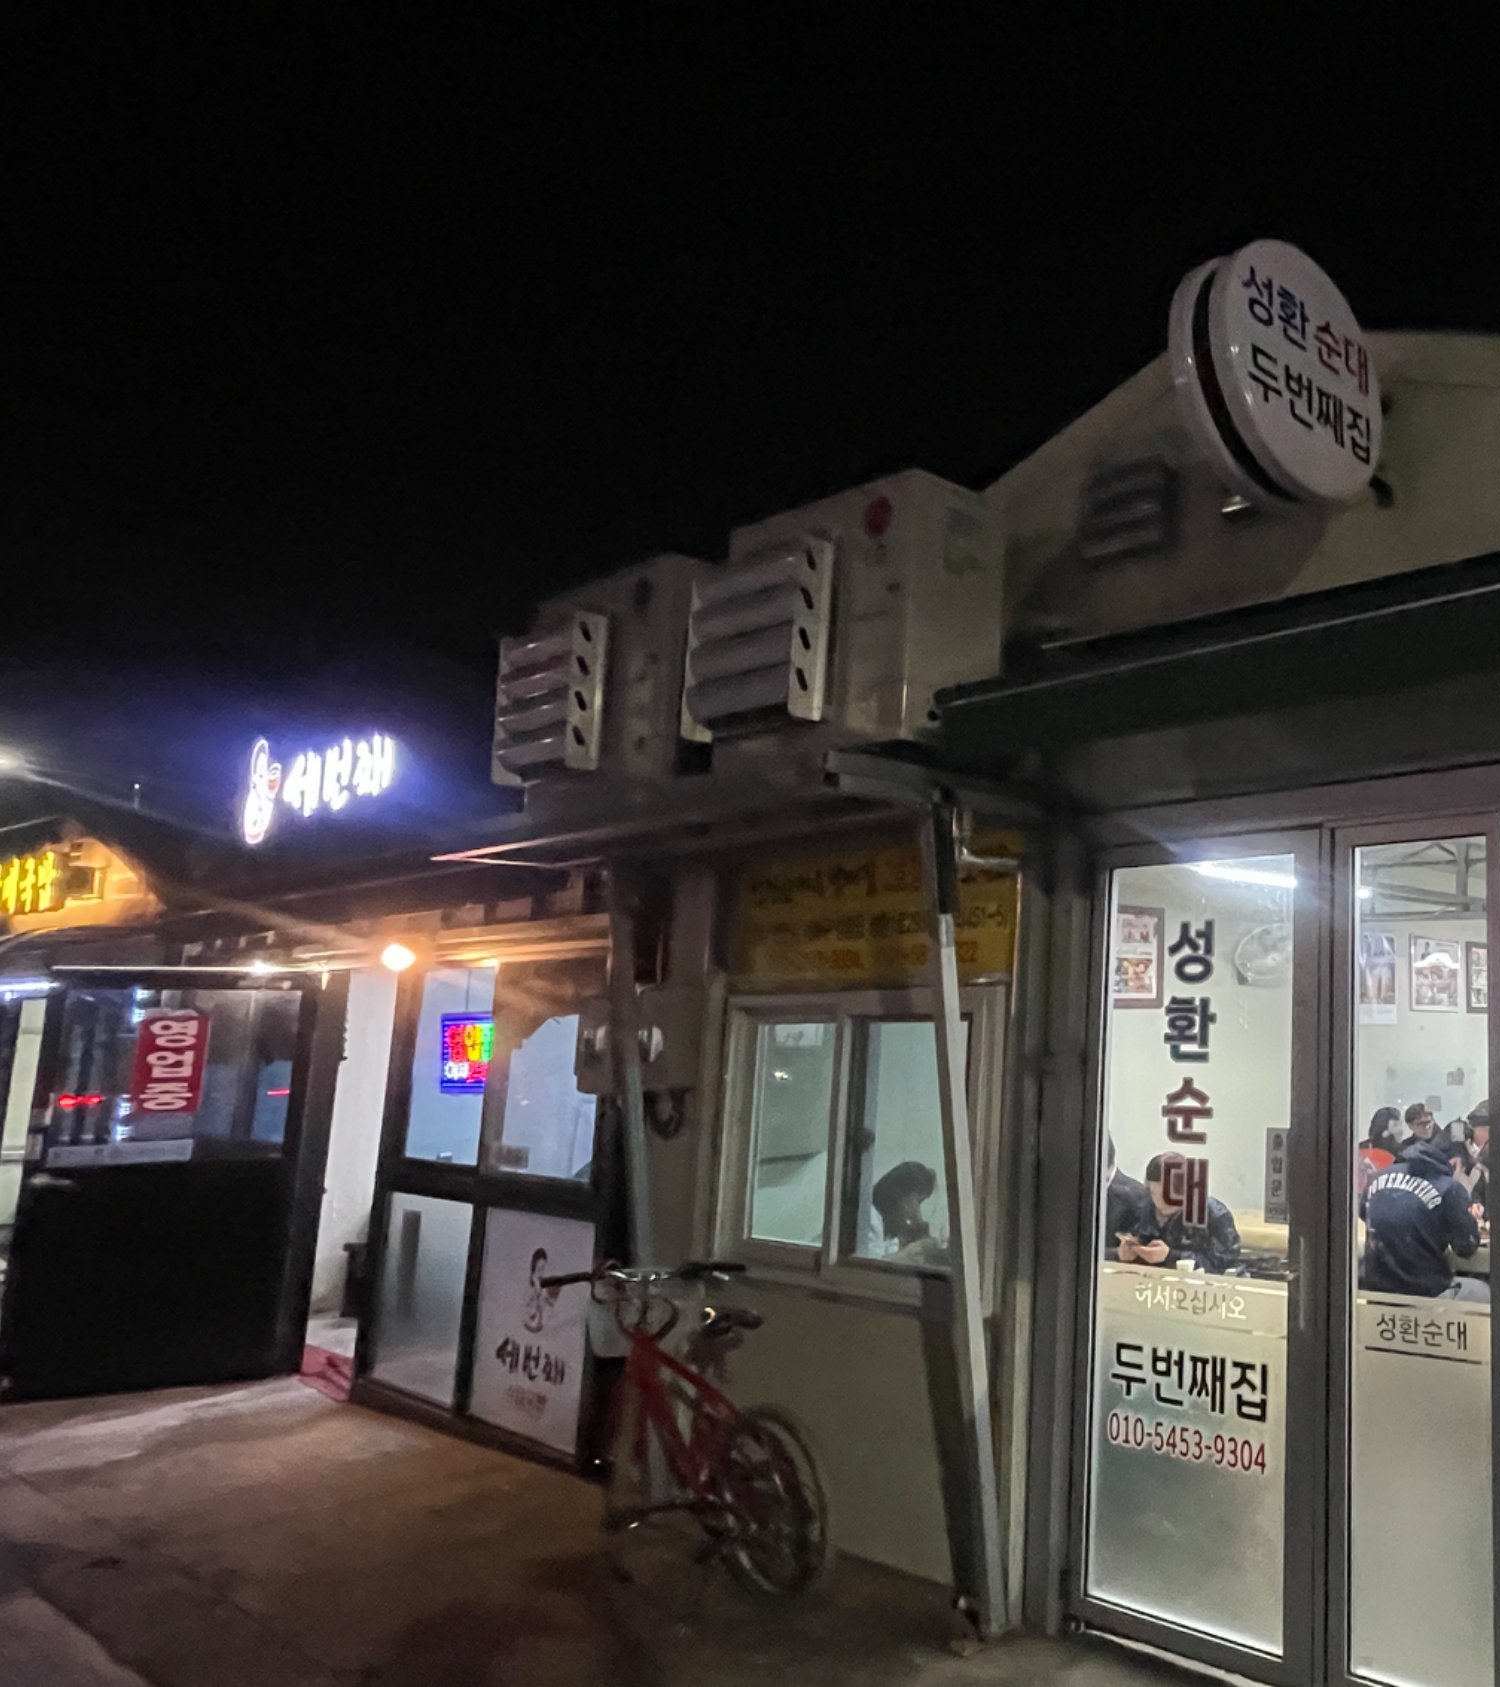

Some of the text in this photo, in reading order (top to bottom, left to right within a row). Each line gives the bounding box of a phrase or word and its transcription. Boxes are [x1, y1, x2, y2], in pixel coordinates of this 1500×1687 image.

[1248, 343, 1371, 466] 두번째집
[1161, 918, 1217, 1229] 성환순대
[1376, 1313, 1467, 1351] 성환순대
[1110, 1342, 1268, 1424] 두번째집
[1108, 1412, 1267, 1476] 010-5453-9304
